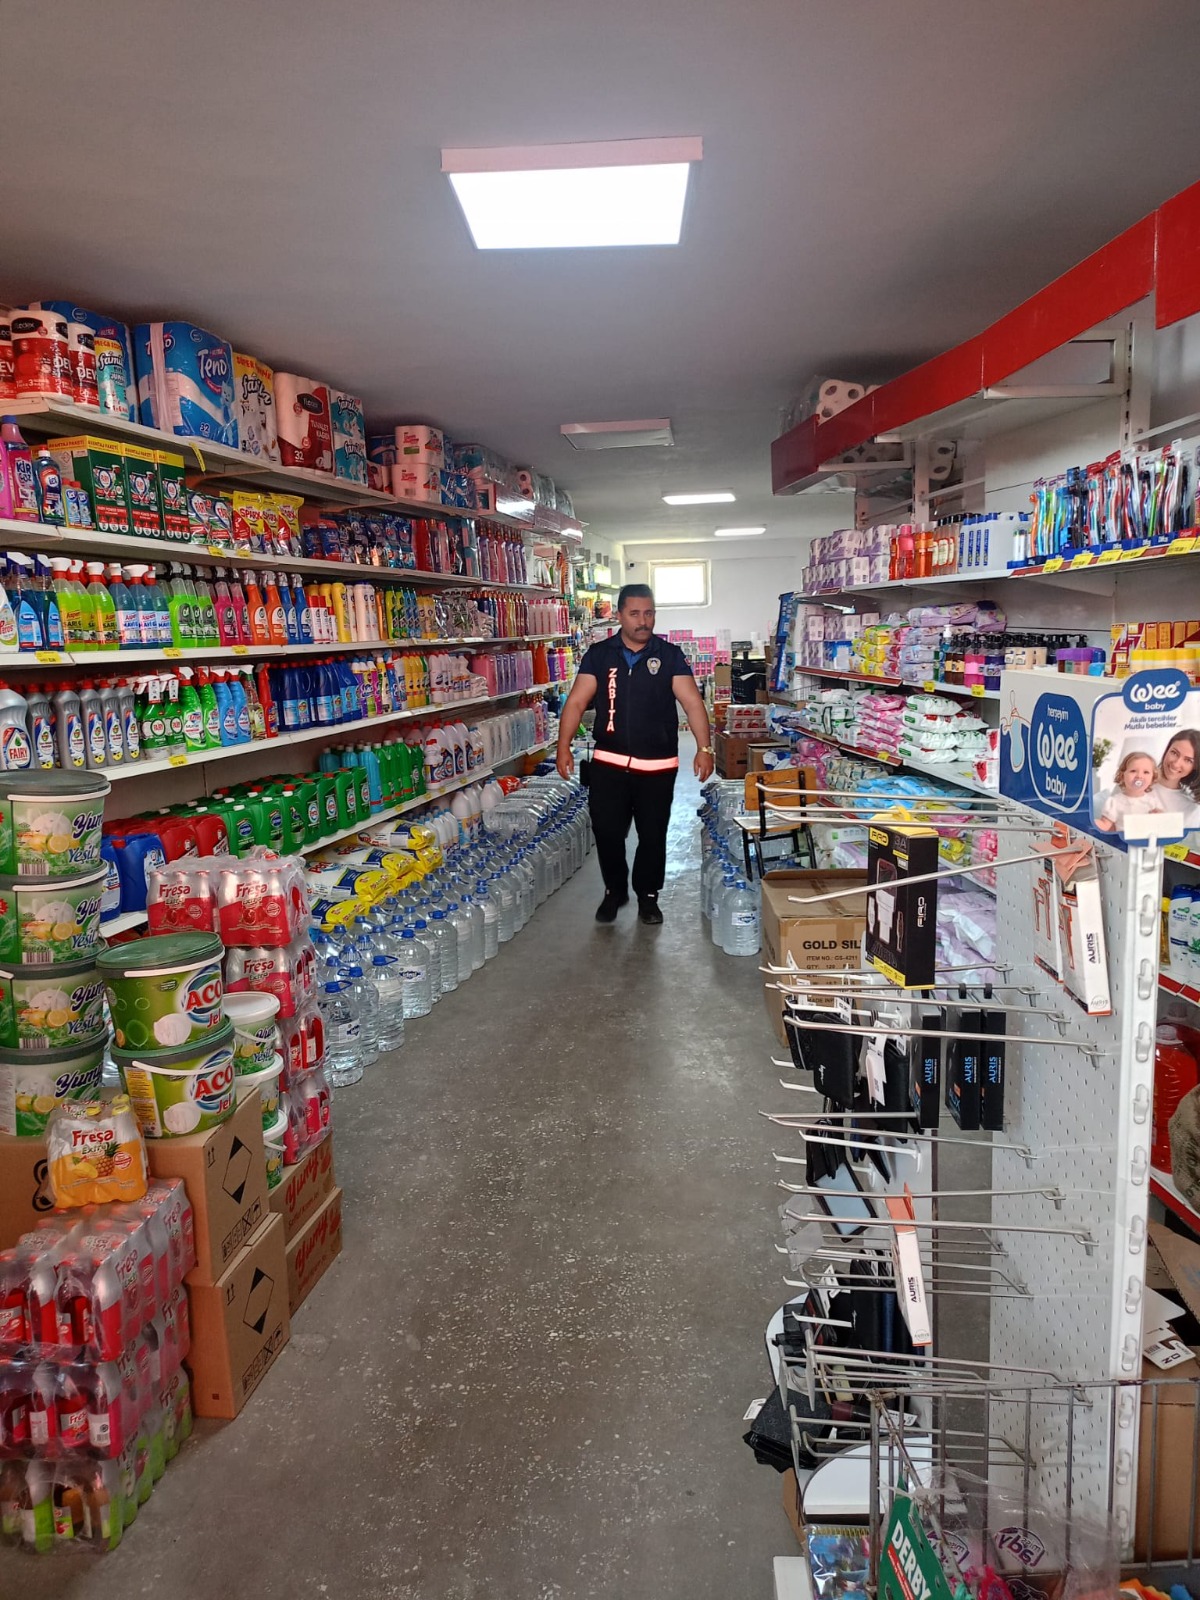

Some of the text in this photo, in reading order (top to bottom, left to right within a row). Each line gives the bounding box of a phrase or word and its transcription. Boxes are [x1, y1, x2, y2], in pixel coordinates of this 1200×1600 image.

[146, 338, 172, 355] To
[198, 349, 227, 378] Teno
[294, 451, 304, 460] 32
[606, 667, 618, 732] ZABITA
[1046, 771, 1066, 801] baby
[803, 940, 861, 949] GOLD SIL
[1086, 933, 1096, 963] AURIS
[184, 980, 222, 1012] ACO
[207, 1009, 222, 1028] Jel
[195, 1066, 233, 1099] ACO
[925, 1058, 933, 1084] AURIS
[217, 1093, 231, 1114] Jel
[82, 1144, 107, 1155] Extra
[908, 1276, 917, 1303] AURIS
[891, 1519, 932, 1600] DERBY
